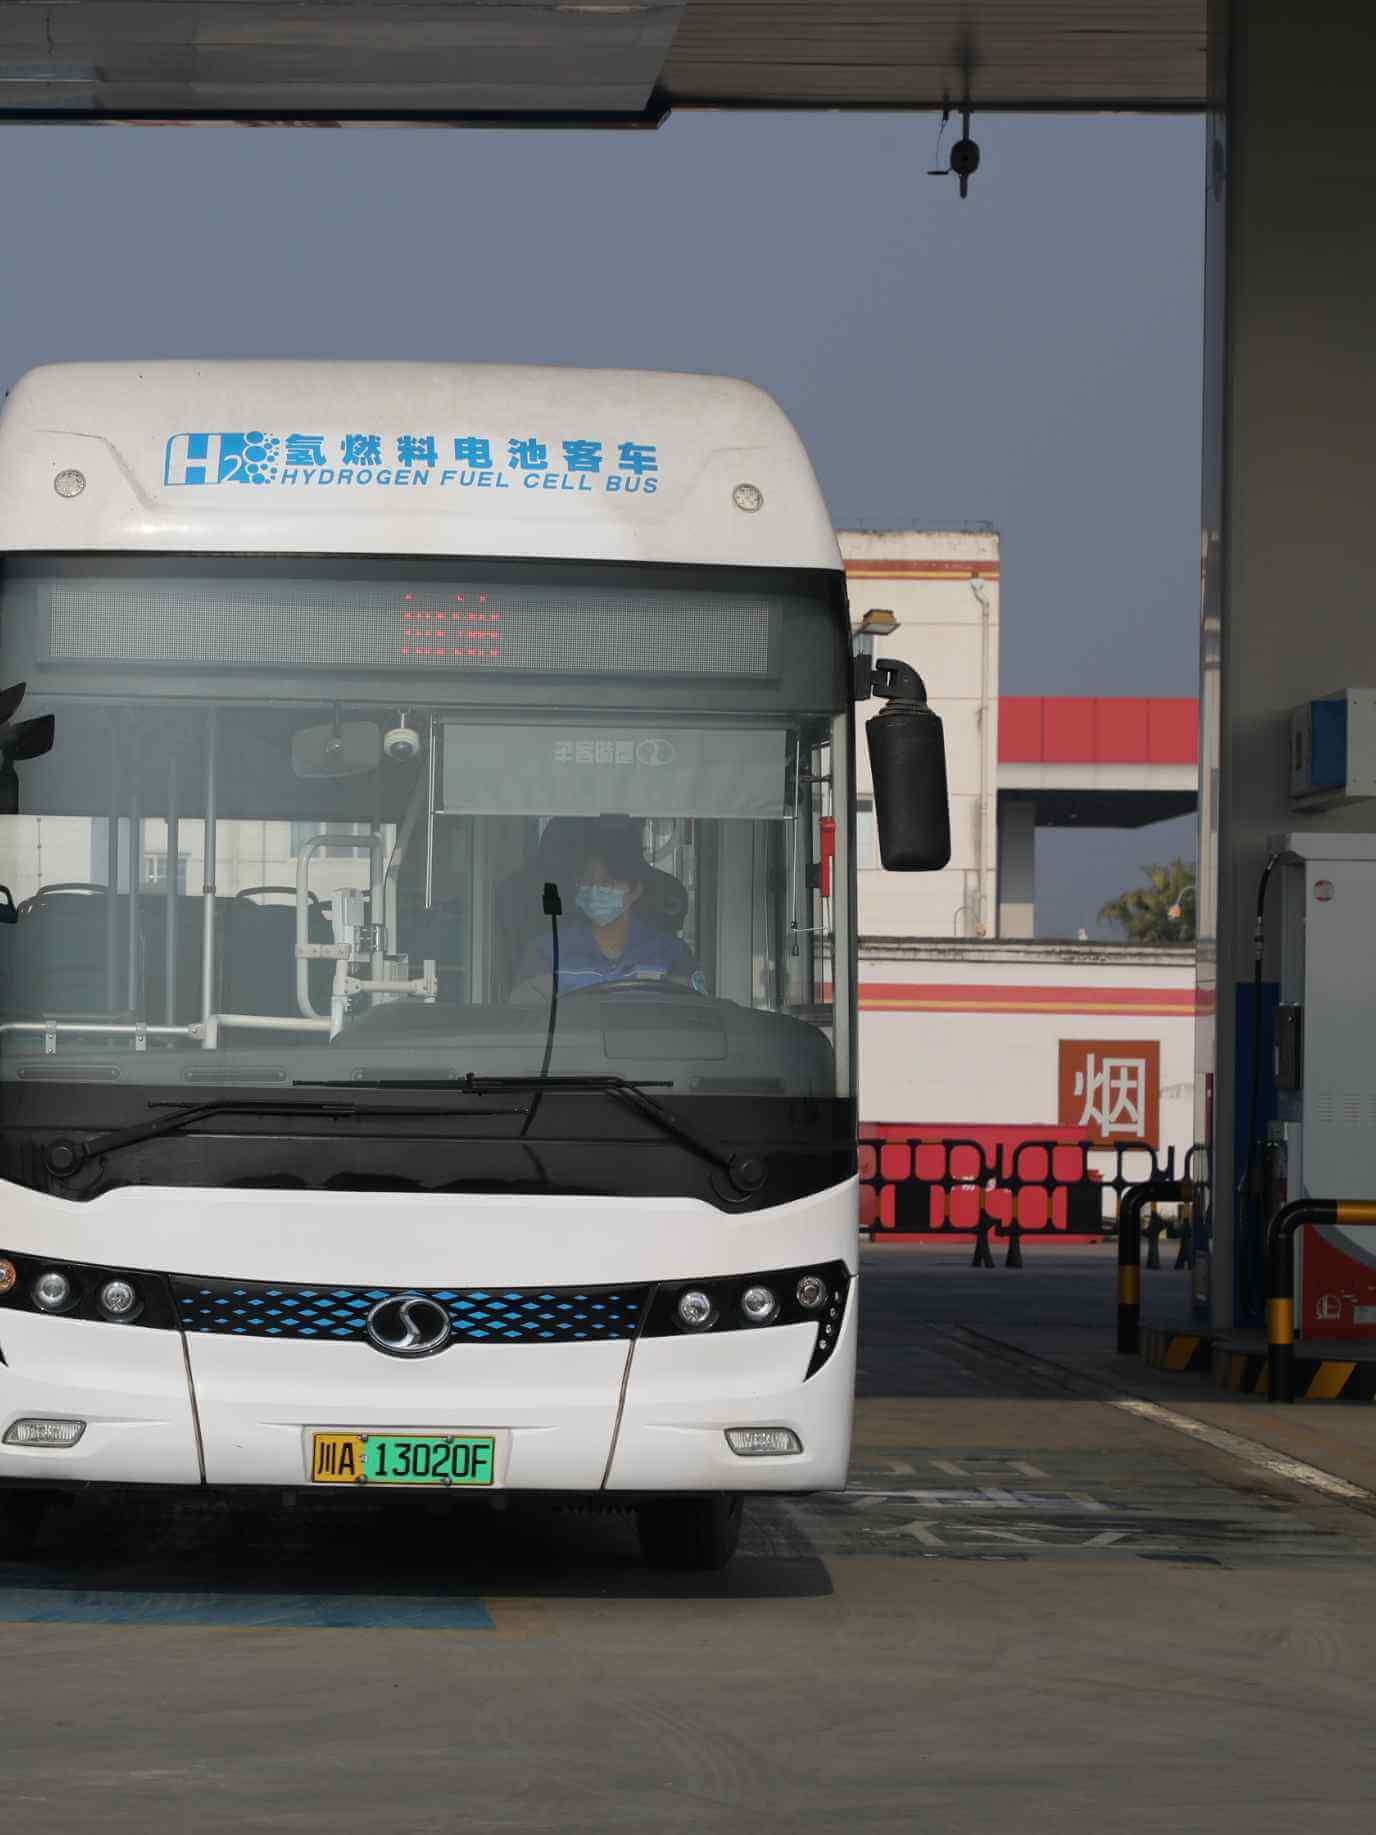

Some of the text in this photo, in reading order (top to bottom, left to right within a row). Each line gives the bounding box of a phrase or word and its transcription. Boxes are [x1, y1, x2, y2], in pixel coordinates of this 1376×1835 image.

[285, 433, 658, 475] 氢燃料电池客车
[280, 468, 658, 493] HYDROGEN FUEL CELL BUS
[1074, 1053, 1145, 1138] 烟
